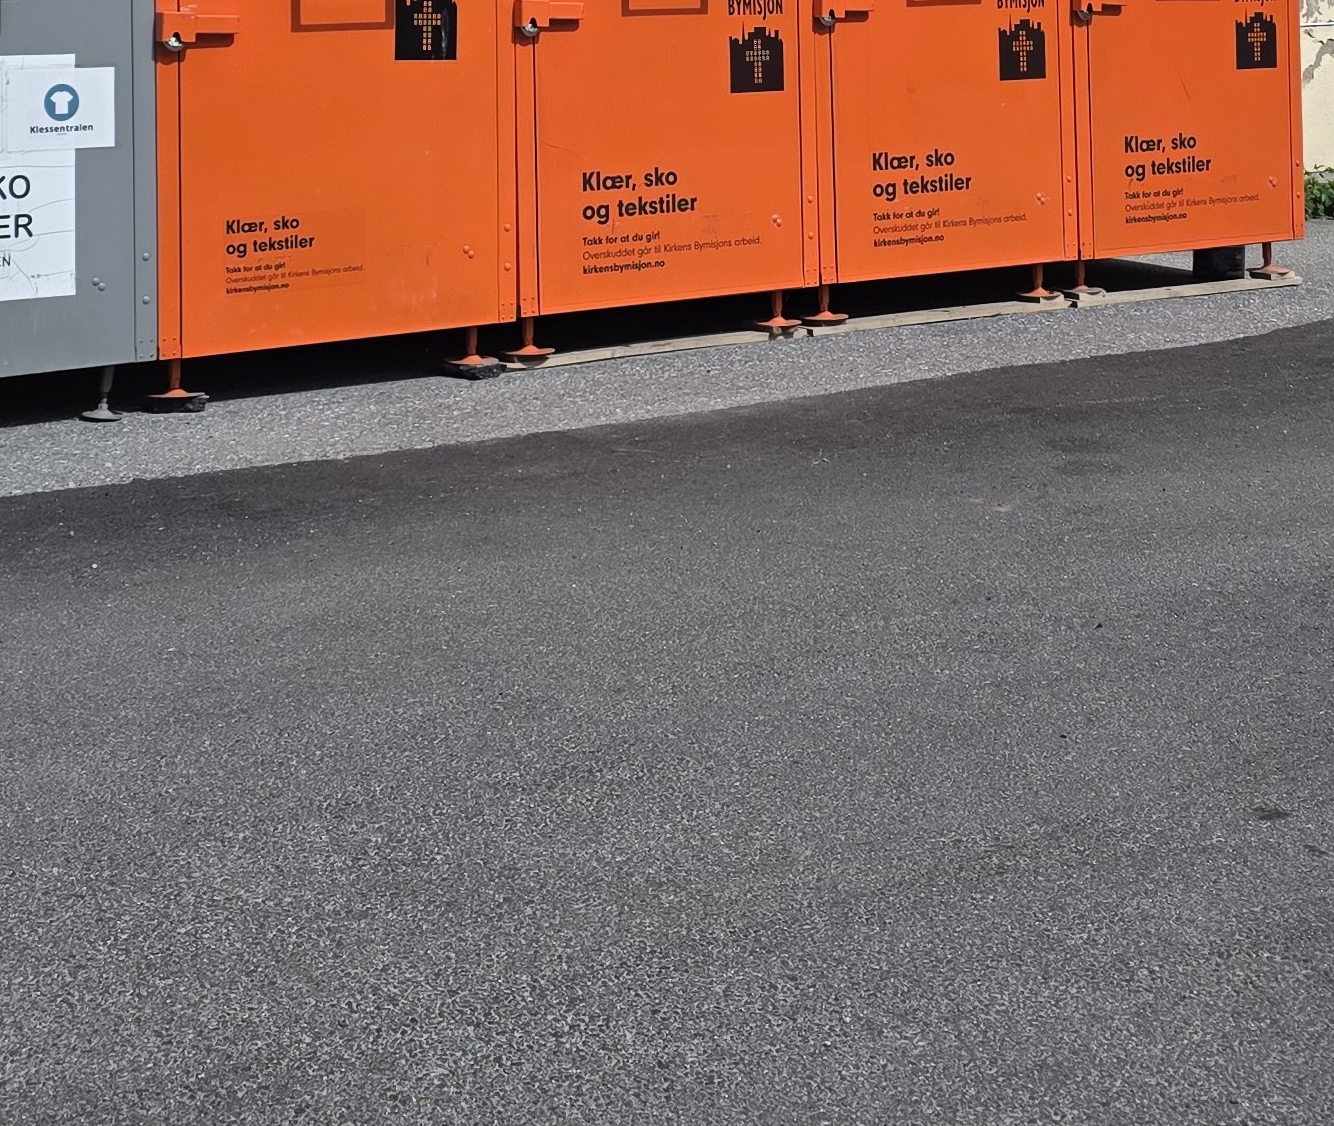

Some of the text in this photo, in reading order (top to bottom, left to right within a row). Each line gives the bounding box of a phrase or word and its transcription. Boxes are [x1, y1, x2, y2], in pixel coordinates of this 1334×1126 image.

[1124, 133, 1197, 153] Klær, sko
[872, 148, 955, 171] Klær, sko
[1125, 156, 1212, 181] og tekstiler
[582, 167, 677, 192] Klær, sko
[873, 173, 972, 201] og tekstiler
[1124, 192, 1140, 200] Takk
[1142, 190, 1152, 198] for
[582, 194, 697, 225] og tekstiler
[873, 212, 891, 221] Takk
[892, 211, 903, 219] for
[226, 215, 300, 234] Klær, sko
[226, 235, 315, 258] og tekstiler
[582, 237, 603, 246] Takk
[605, 235, 618, 244] for
[621, 234, 629, 243] at
[632, 233, 643, 242] du
[582, 248, 635, 261] Overskuddet
[637, 246, 651, 259] går
[664, 242, 691, 253] Kirkens
[694, 239, 732, 252] Bymisjons
[582, 260, 665, 275] kirkensbymisjon.no
